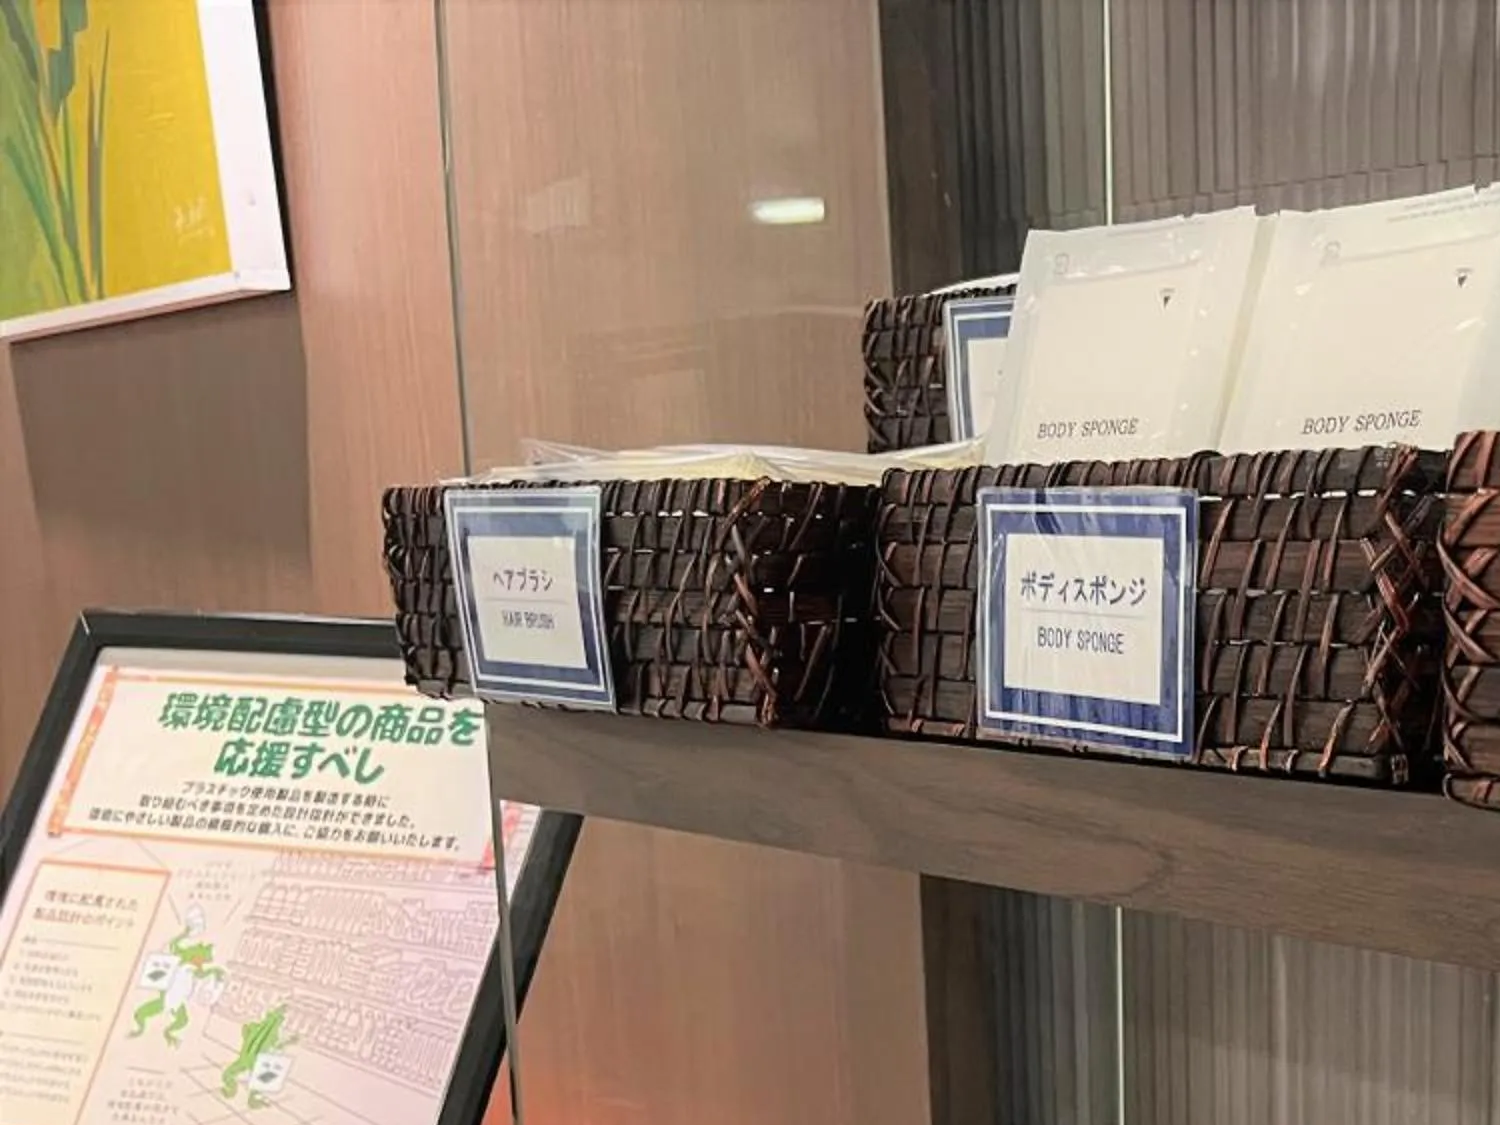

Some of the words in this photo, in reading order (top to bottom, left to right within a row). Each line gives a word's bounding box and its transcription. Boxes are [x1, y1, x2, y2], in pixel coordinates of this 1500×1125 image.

[1038, 421, 1076, 440] BODY
[1081, 418, 1139, 438] SPONGE
[1303, 415, 1350, 435] BODY
[1354, 409, 1422, 433] SPONGE
[492, 568, 553, 592] ヘアブラシ
[1020, 570, 1148, 607] ボディスポンジ
[501, 610, 523, 628] HAIR
[525, 612, 556, 630] BRUSH
[1037, 626, 1074, 649] BODY
[1077, 630, 1125, 656] SPONGE
[158, 692, 484, 747] 環境配慮型の商品を
[213, 738, 385, 785] 応援すべし
